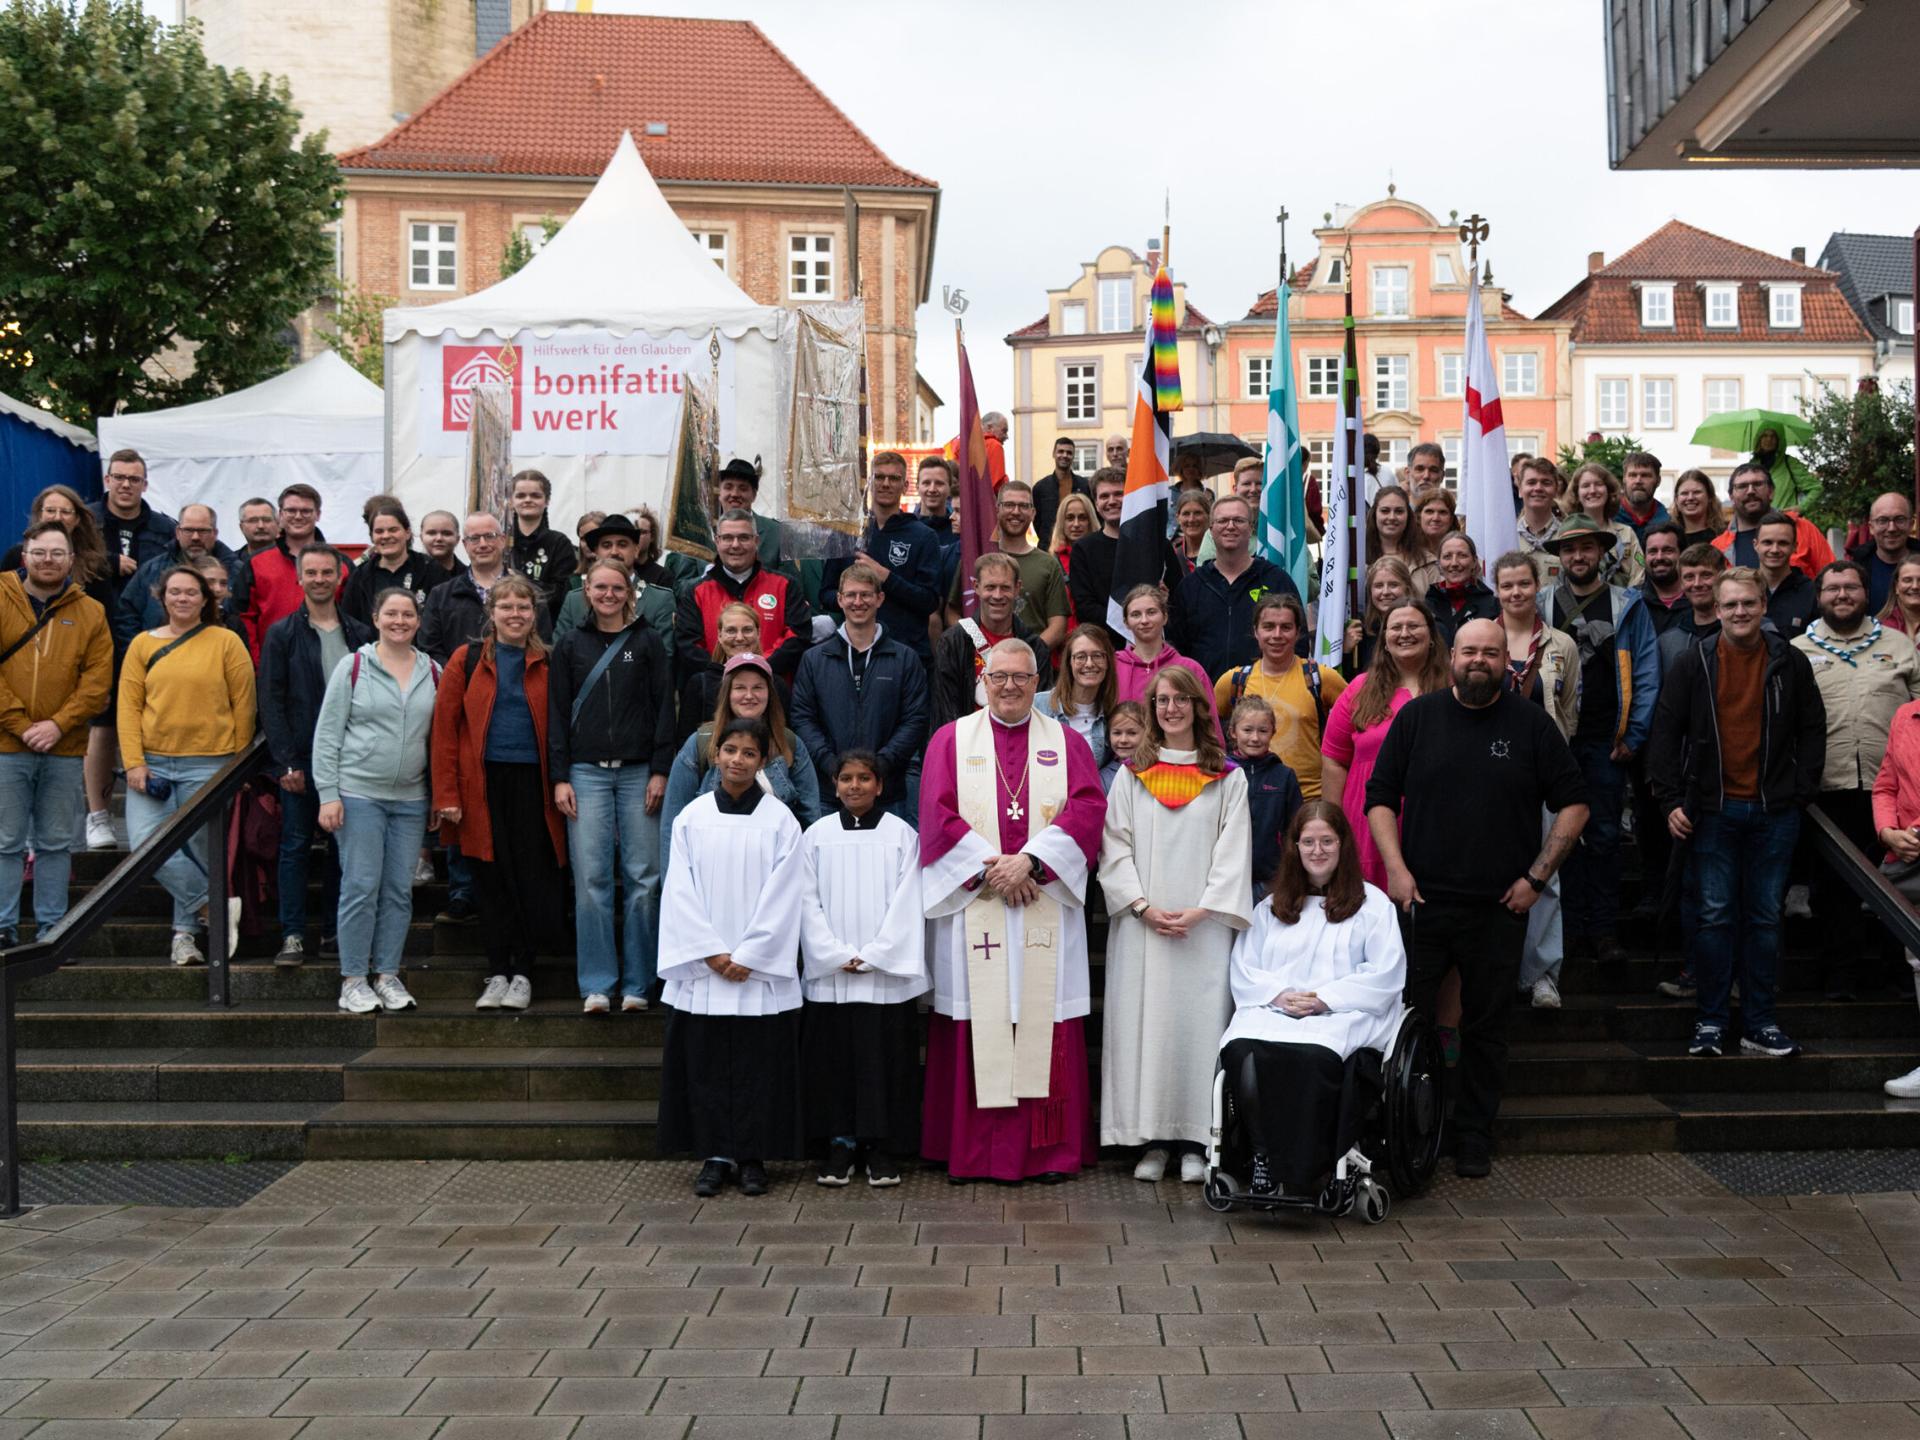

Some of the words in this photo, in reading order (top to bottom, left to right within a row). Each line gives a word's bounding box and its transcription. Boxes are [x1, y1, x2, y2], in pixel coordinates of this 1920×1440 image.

[533, 344, 589, 356] Hilfswerk
[593, 343, 609, 355] für
[614, 343, 637, 355] den
[641, 343, 692, 355] Glauben
[533, 401, 618, 431] werk
